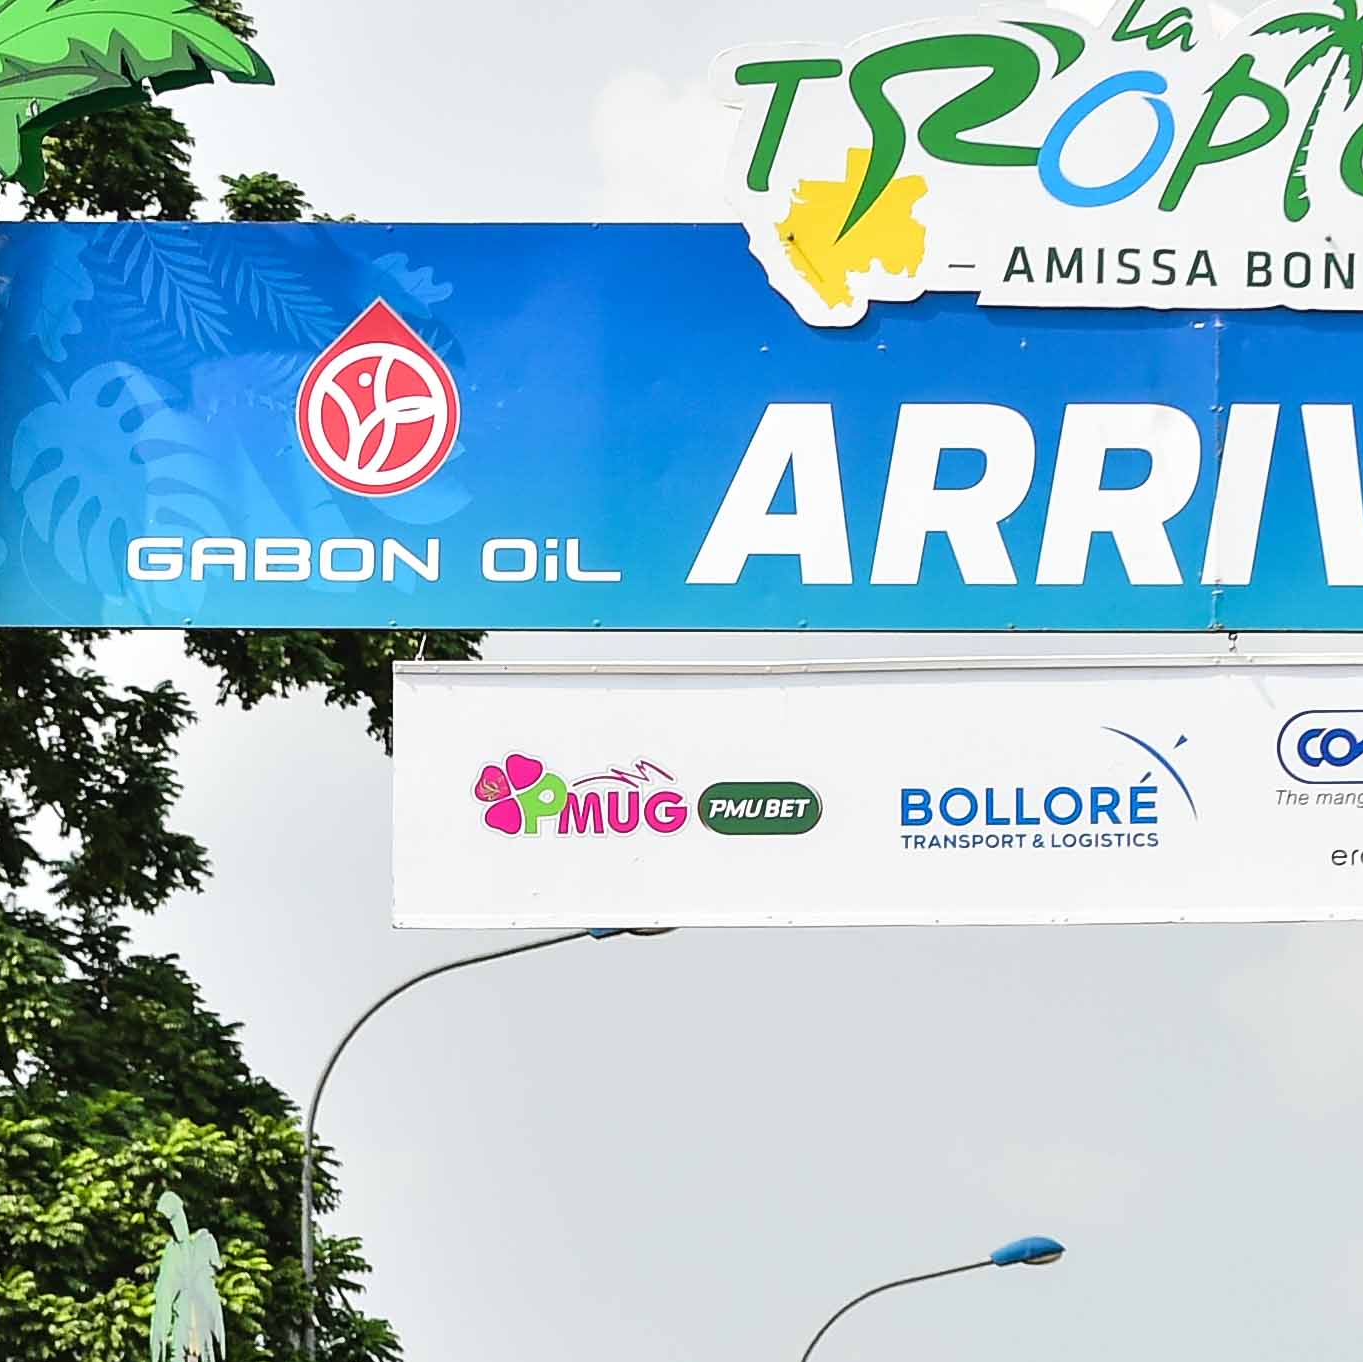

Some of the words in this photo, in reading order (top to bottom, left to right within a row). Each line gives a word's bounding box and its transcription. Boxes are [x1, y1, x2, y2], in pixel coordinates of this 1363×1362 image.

[1114, 0, 1197, 51] La
[1003, 246, 1220, 289] AMISSA
[127, 537, 440, 582] GABON
[900, 771, 1159, 827] BOLLORÉ
[1276, 789, 1309, 806] The
[901, 834, 1028, 851] TRANSPORT
[1032, 833, 1045, 849] &
[1050, 831, 1160, 849] LOGISTICS
